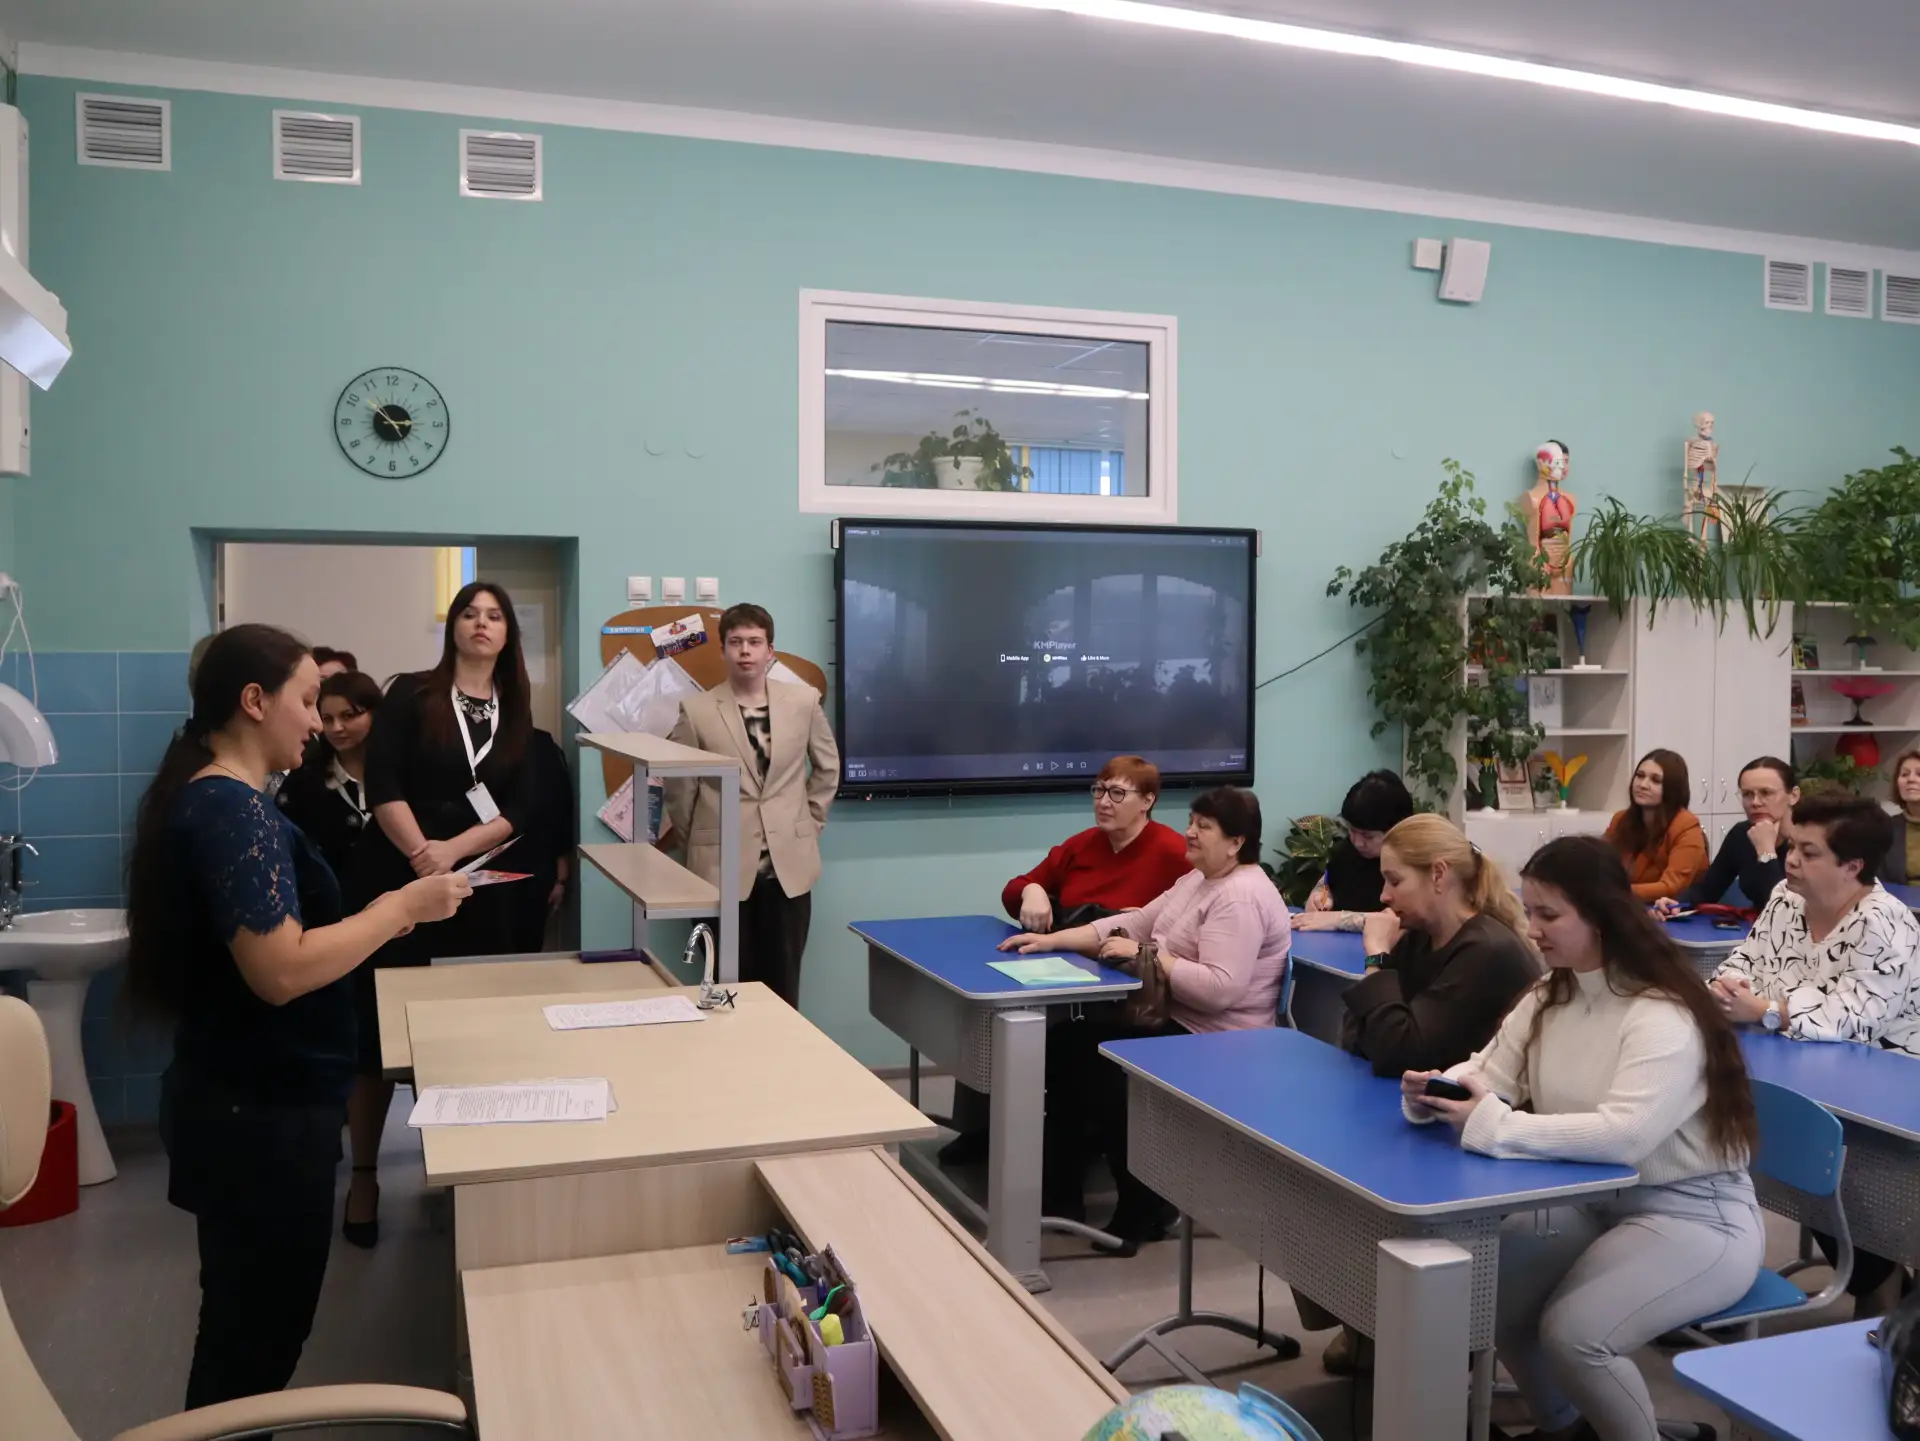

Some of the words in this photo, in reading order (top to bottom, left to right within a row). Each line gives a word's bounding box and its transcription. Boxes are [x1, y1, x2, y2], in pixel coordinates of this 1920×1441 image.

[363, 378, 377, 392] 11
[386, 375, 399, 386] 12
[411, 382, 419, 392] 1
[346, 393, 360, 407] 10
[426, 399, 438, 409] 2
[432, 420, 443, 428] 3
[349, 439, 361, 448] 8
[424, 441, 433, 450] 4
[366, 455, 376, 465] 7
[409, 455, 419, 466] 5
[388, 460, 396, 471] 6
[1033, 640, 1077, 650] KMPlayer
